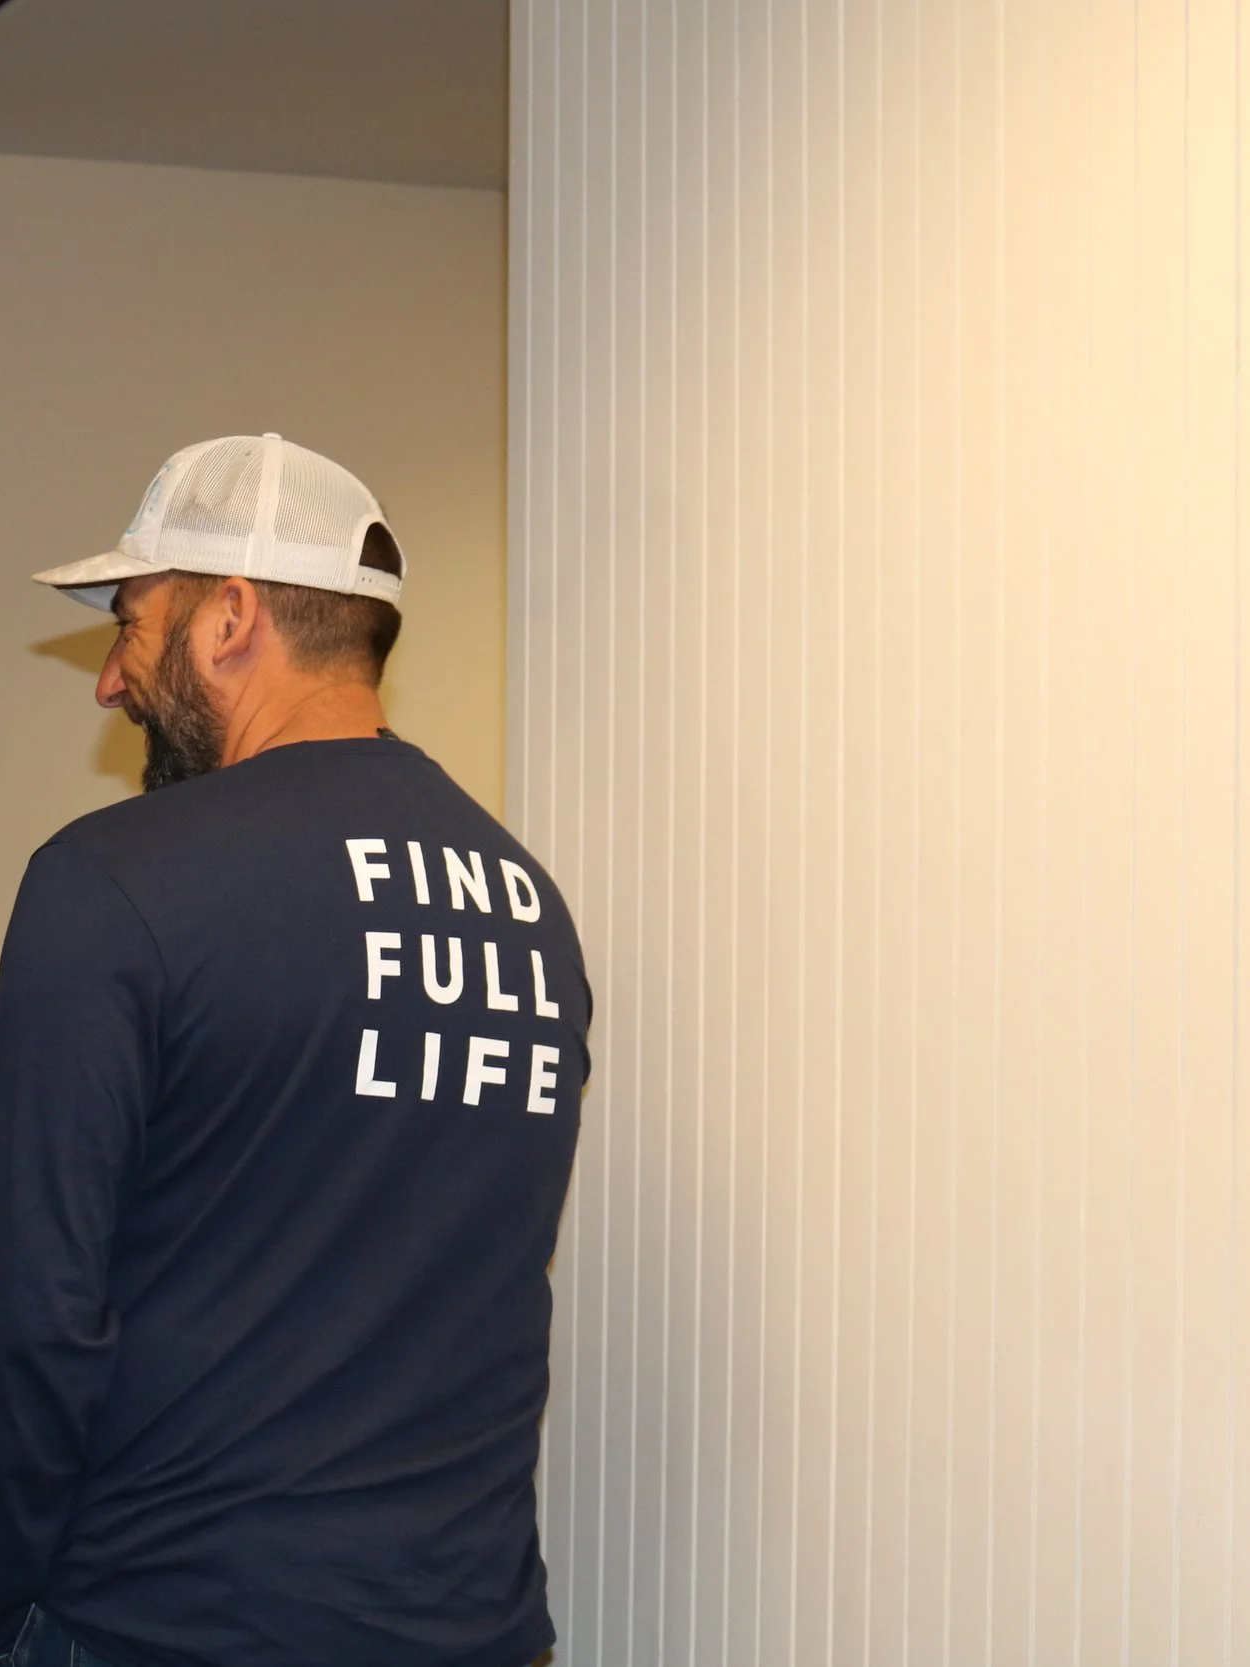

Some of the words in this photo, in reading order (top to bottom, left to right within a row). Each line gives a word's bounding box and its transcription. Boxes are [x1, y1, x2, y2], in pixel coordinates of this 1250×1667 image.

[346, 838, 541, 923] FIND
[365, 931, 560, 1019] FULL
[355, 1028, 560, 1115] LIFE
